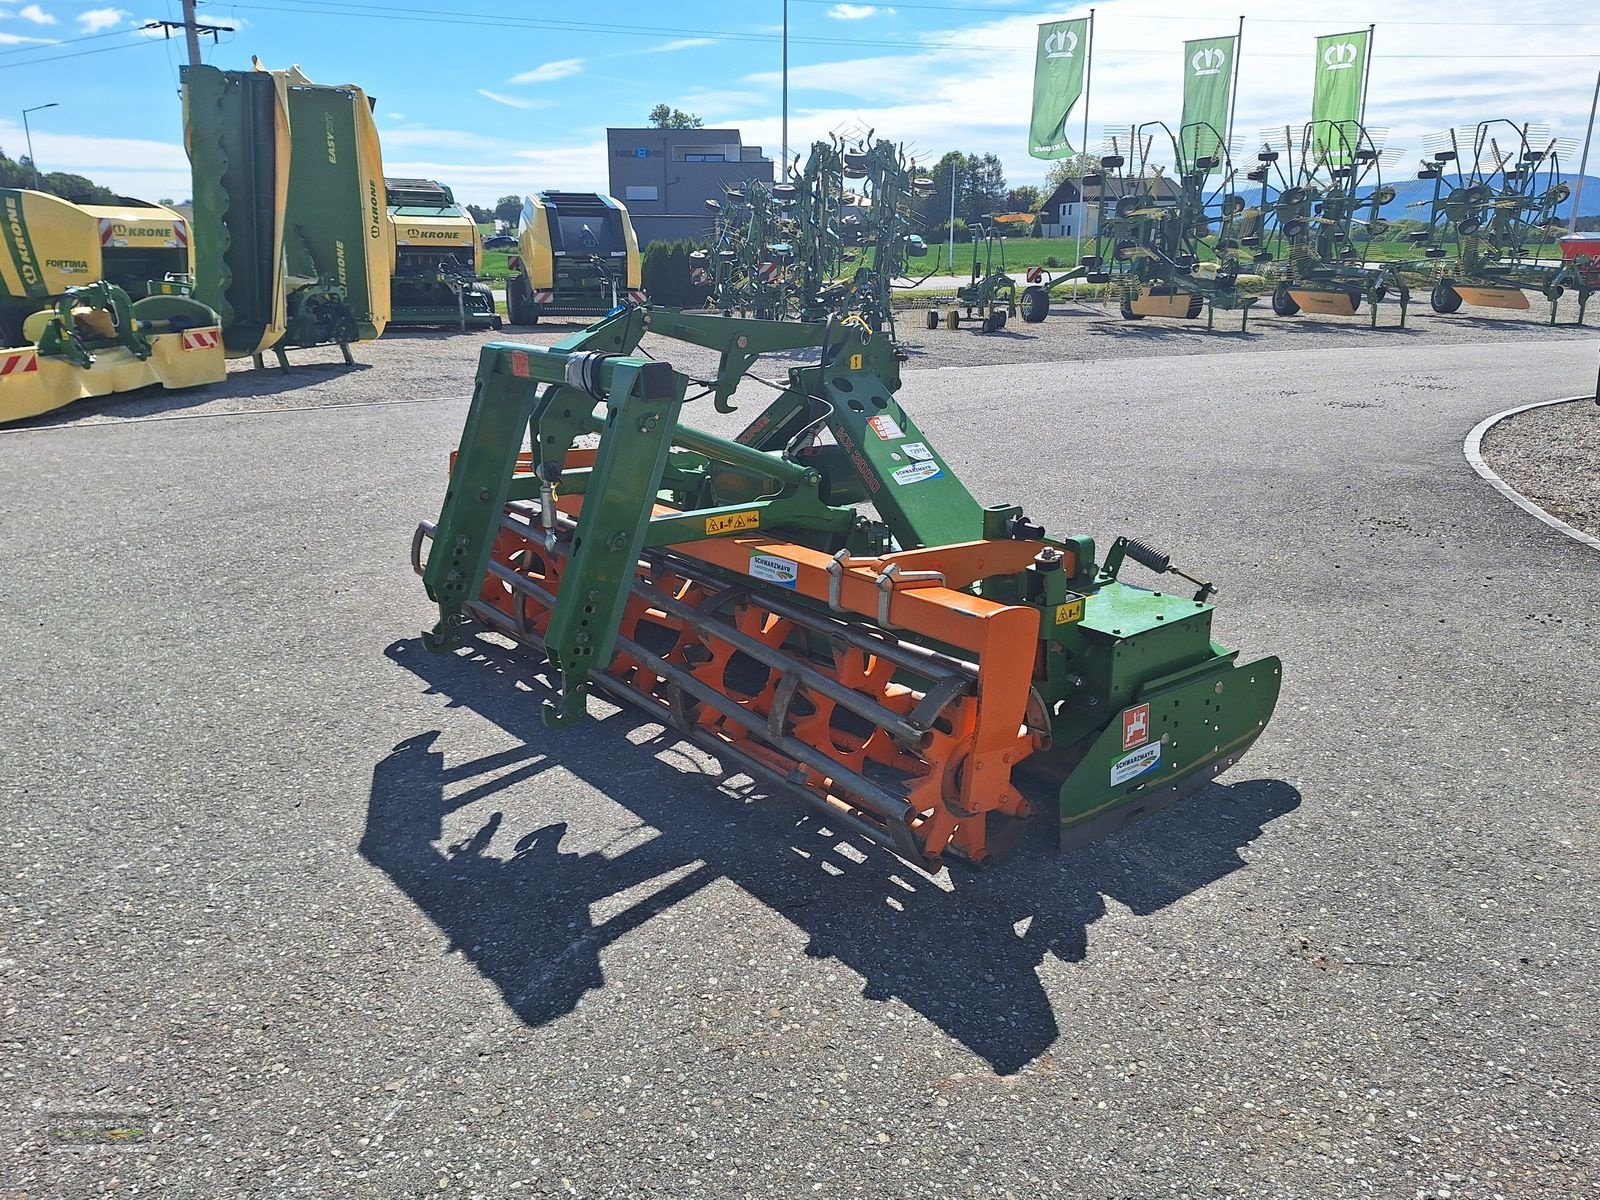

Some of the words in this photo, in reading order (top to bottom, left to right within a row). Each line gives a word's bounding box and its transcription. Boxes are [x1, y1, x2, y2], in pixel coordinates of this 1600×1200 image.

[369, 179, 380, 225] KRONE
[6, 197, 31, 264] KRONE
[128, 228, 171, 237] KRONE
[421, 231, 460, 239] KRONE
[46, 259, 88, 269] FORTIMA
[336, 240, 347, 285] KRONE
[836, 426, 855, 453] KX
[851, 449, 880, 493] 3000
[754, 556, 791, 572] SCHWARZMAYR
[1115, 749, 1154, 770] SCHWARZMAYR
